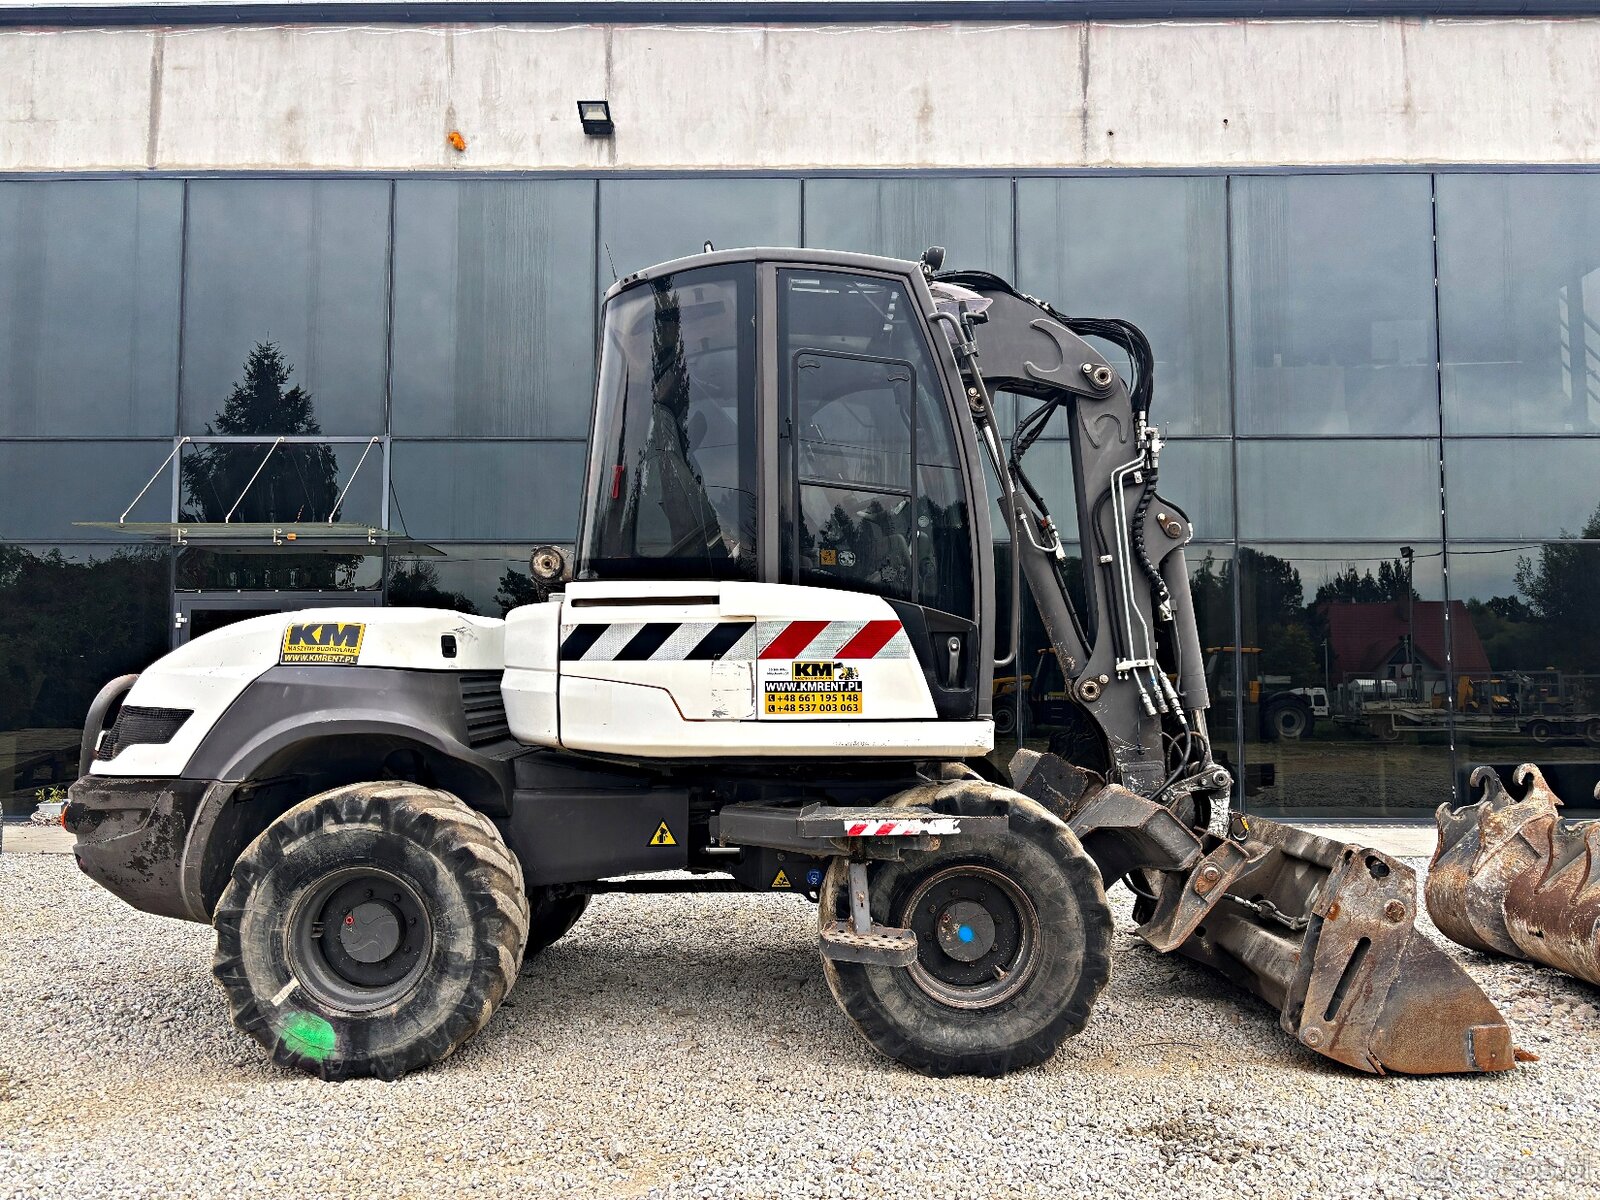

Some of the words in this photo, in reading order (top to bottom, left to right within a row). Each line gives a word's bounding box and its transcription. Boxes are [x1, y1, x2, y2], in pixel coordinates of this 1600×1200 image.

[289, 624, 361, 647] KM
[284, 654, 356, 663] WWW.KMRENT.PL
[795, 663, 832, 676] KM
[766, 682, 862, 692] WWW.KMRENT.PL
[778, 694, 796, 702] +48
[798, 694, 816, 702] 661
[820, 694, 837, 702] 195
[841, 694, 859, 702] 148
[778, 704, 796, 712] +48
[798, 704, 816, 712] 537
[820, 704, 837, 712] 003
[840, 704, 859, 712] 063
